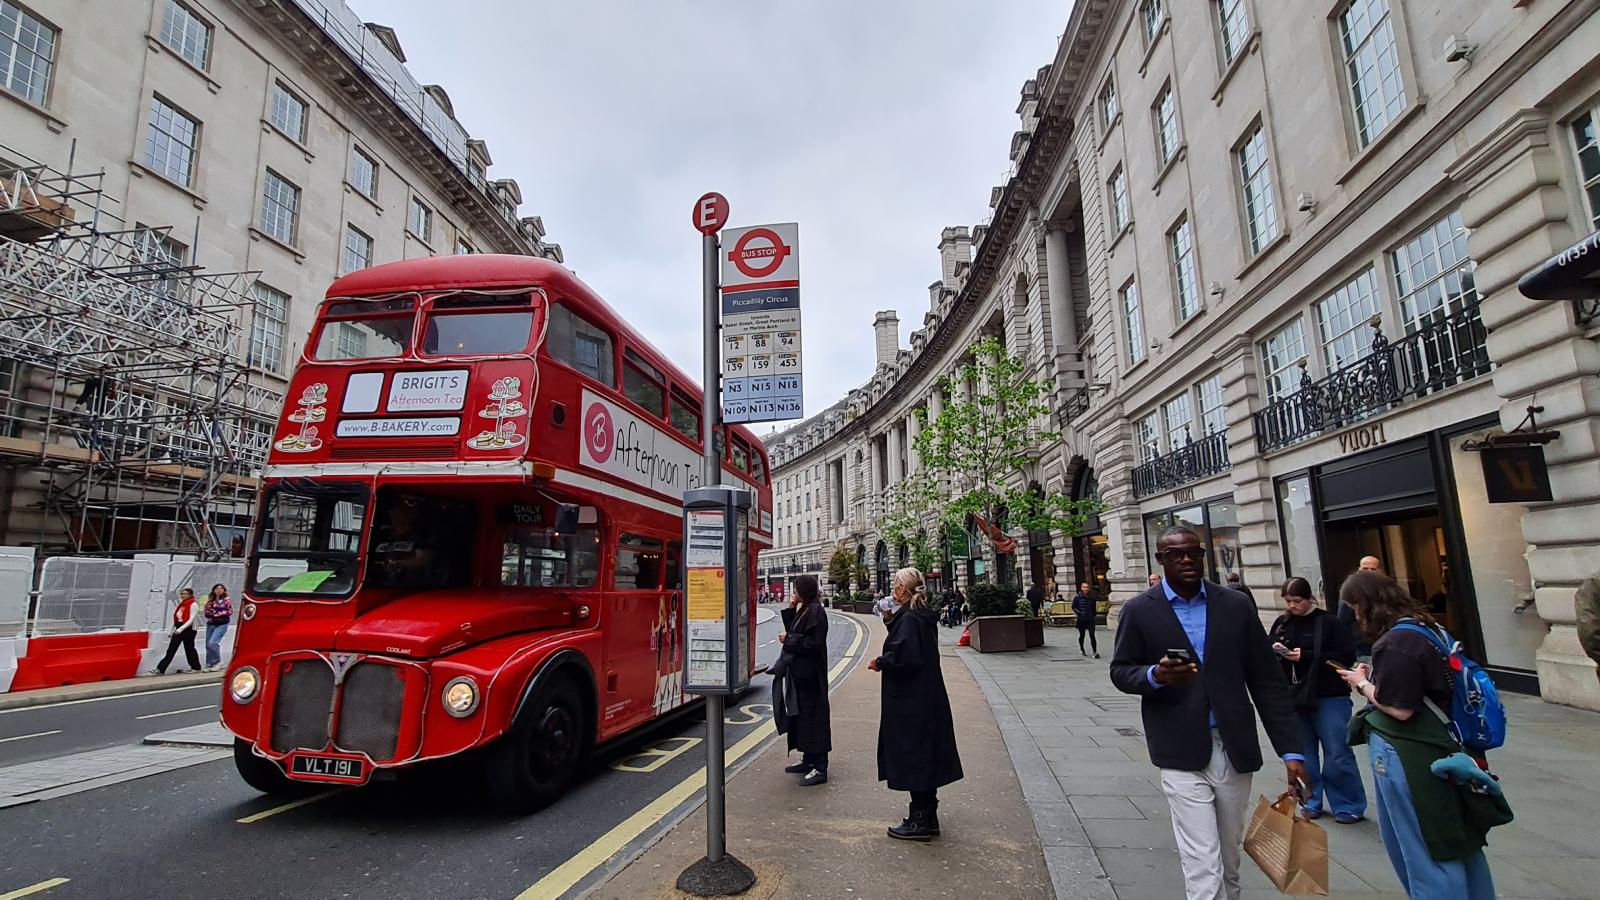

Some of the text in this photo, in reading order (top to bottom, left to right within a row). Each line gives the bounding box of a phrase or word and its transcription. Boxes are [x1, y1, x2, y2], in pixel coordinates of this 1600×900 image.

[701, 198, 717, 227] E
[741, 248, 777, 258] BUS STOP
[732, 298, 765, 306] Piccadilly
[729, 342, 740, 350] 12
[755, 340, 767, 348] 88
[781, 338, 793, 346] 94
[727, 362, 743, 371] 139
[753, 360, 769, 369] 159
[780, 358, 797, 367] 453
[401, 376, 459, 390] BRIGIT'S
[752, 382, 771, 392] N15
[778, 380, 798, 390] N18
[728, 384, 742, 393] N3
[391, 394, 462, 405] Afternoon Tea
[724, 406, 747, 416] N109
[749, 403, 775, 414] N113
[777, 402, 801, 412] N136
[344, 421, 453, 432] www.B-BAKERY.com
[614, 420, 701, 491] Afternoon Tea
[513, 503, 541, 514] DAILY
[516, 513, 543, 523] TOUR
[386, 646, 411, 655] COOLANT
[305, 757, 351, 775] VLT 191
